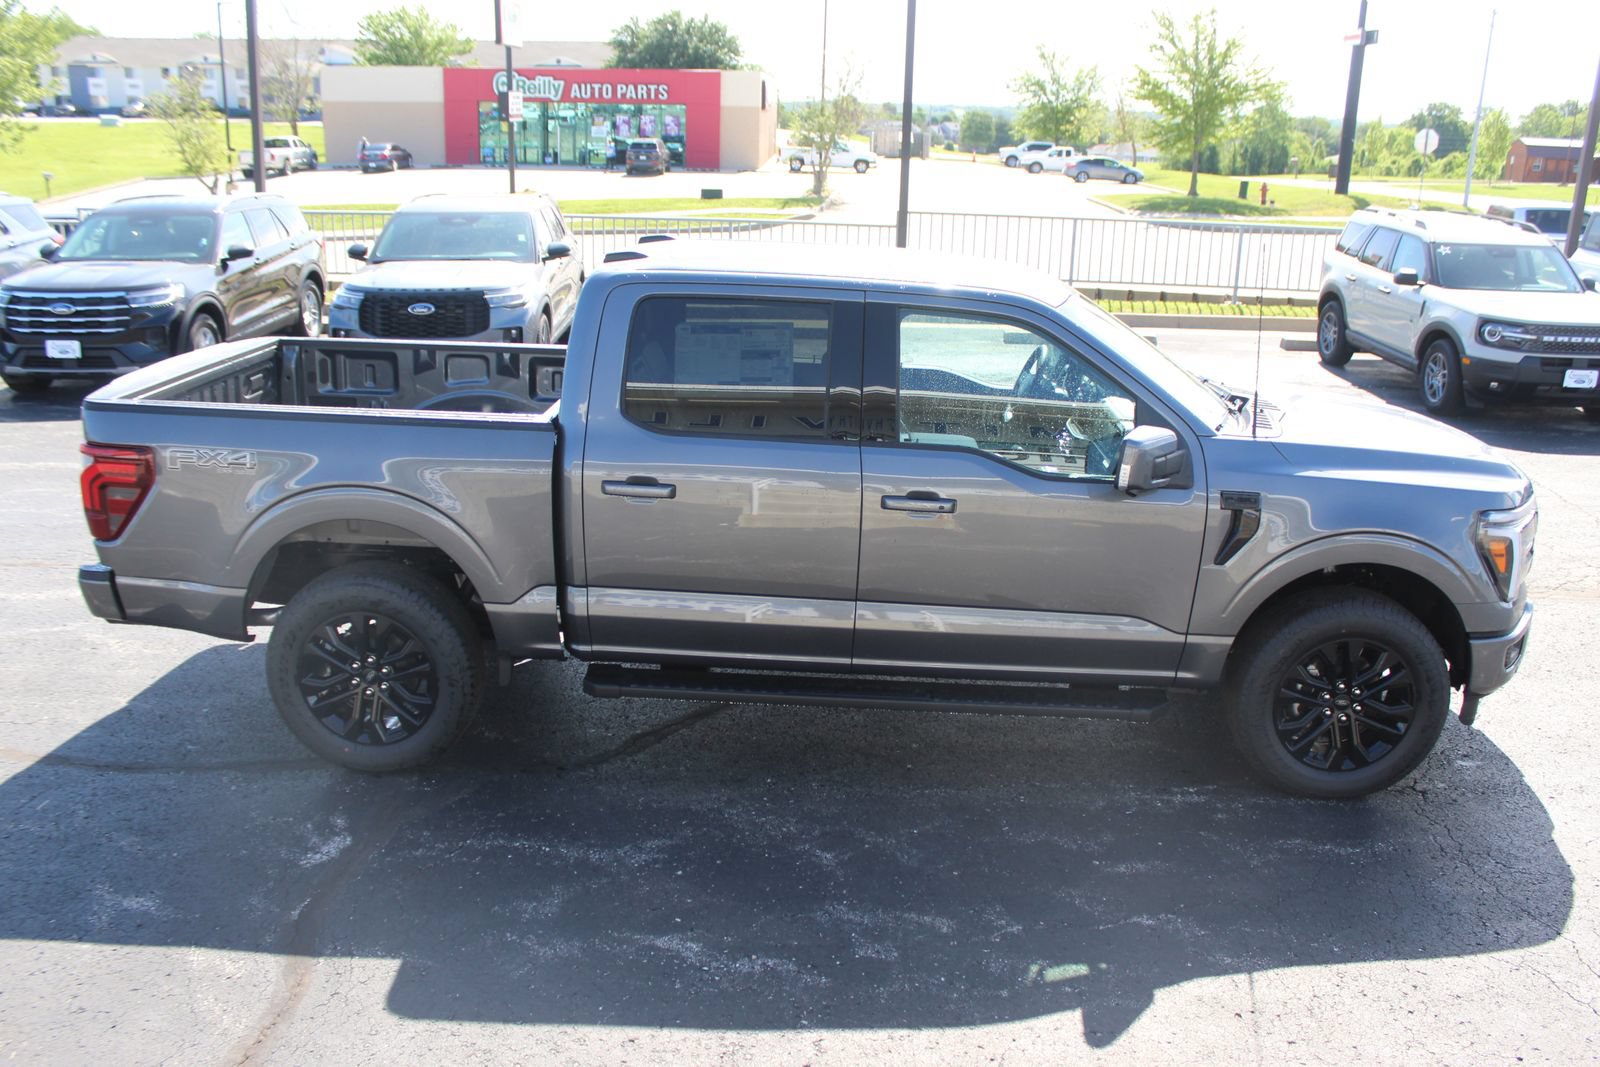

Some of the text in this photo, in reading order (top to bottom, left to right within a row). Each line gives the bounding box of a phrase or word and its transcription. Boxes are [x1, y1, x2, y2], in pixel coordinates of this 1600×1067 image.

[570, 82, 613, 99] AUTO
[616, 83, 669, 100] PARTS
[167, 447, 257, 470] FX4
